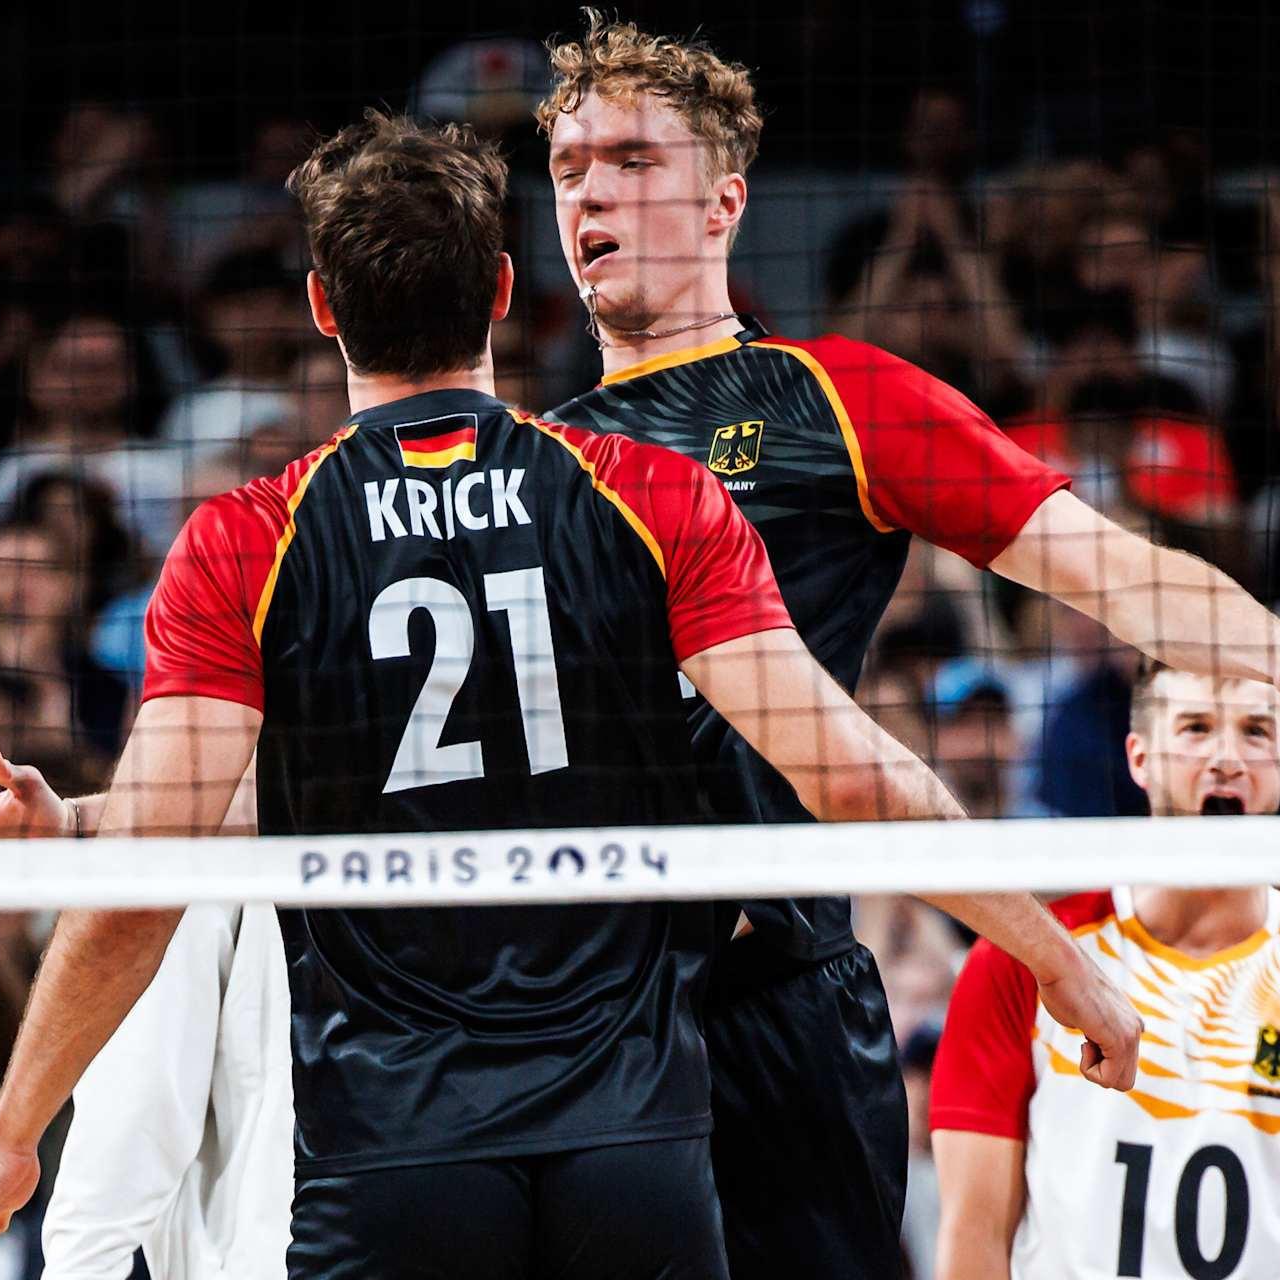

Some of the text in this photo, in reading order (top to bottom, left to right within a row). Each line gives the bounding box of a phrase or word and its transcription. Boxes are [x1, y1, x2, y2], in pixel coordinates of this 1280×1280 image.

[363, 467, 532, 542] KRICK
[368, 566, 569, 794] 21
[506, 840, 668, 883] 2024
